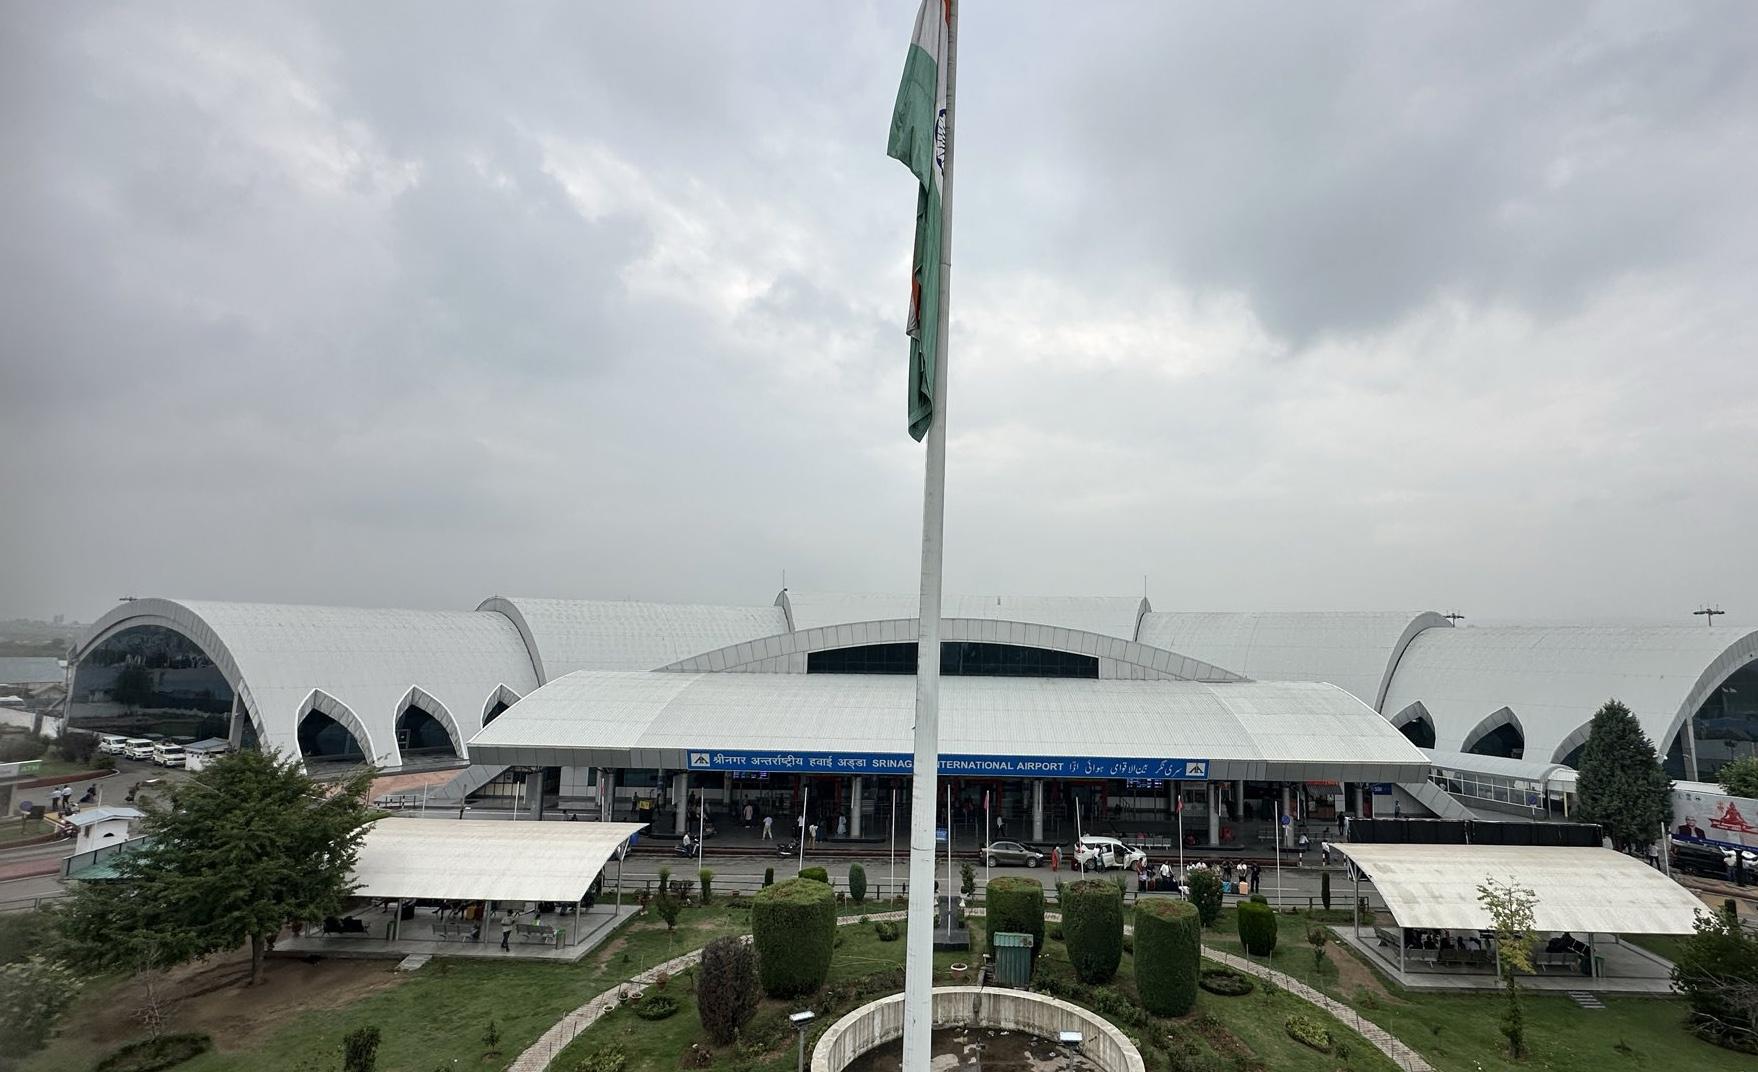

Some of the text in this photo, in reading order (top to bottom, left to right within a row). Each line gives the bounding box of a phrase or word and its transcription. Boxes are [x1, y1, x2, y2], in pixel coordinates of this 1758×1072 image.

[713, 753, 746, 765] श्रीनगर
[809, 755, 833, 767] हवाई
[872, 759, 1064, 771] SRINAG TERNATIONAL AIRPORT
